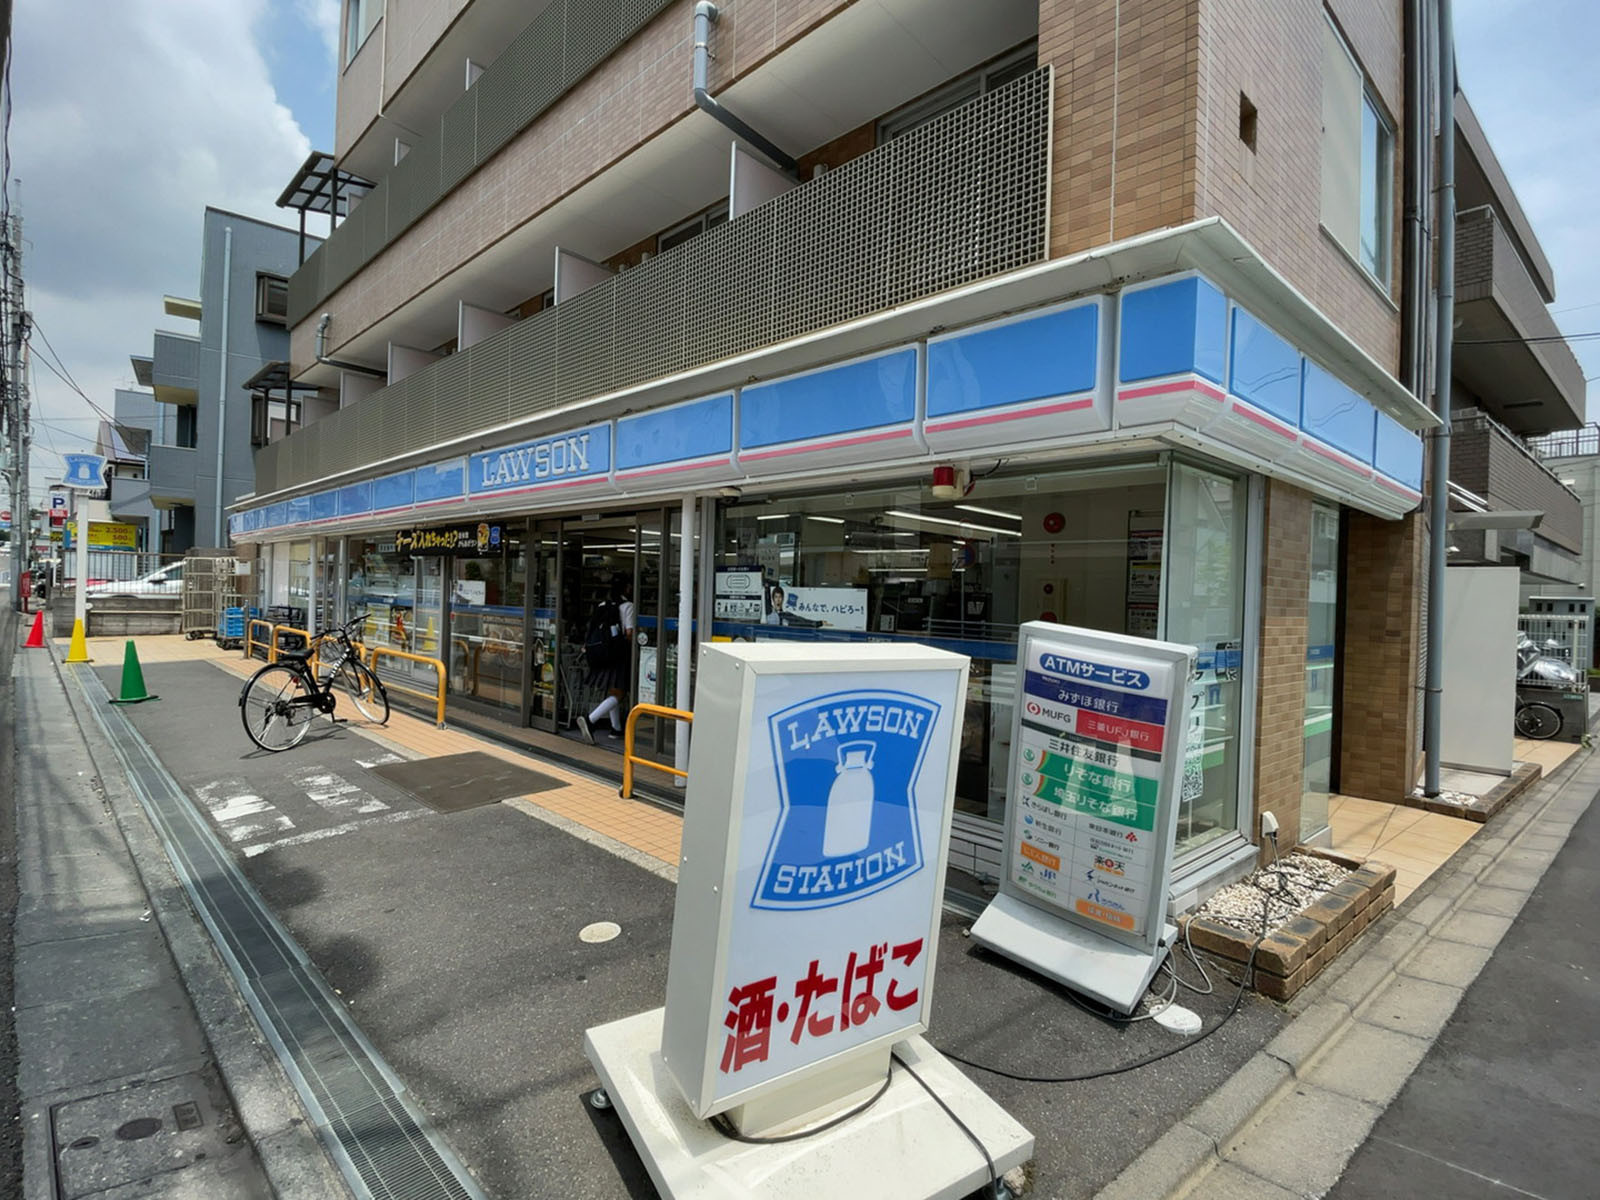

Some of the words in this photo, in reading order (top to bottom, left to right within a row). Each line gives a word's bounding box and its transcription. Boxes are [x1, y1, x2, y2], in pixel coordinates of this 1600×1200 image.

[482, 434, 590, 487] LAWSON
[52, 498, 65, 508] P
[1043, 656, 1144, 689] ATMサービス
[1041, 707, 1072, 724] MUFG
[1057, 688, 1120, 714] みずほ銀行
[787, 704, 925, 751] LAWSON
[1087, 720, 1150, 742] 三菱UFJ銀行
[1048, 738, 1119, 767] 三井住友銀行
[1064, 762, 1132, 793] りそな銀行
[1053, 786, 1138, 821] 埼玉りそな銀行
[773, 841, 906, 894] STATION
[720, 937, 925, 1075] 酒・たばこ
